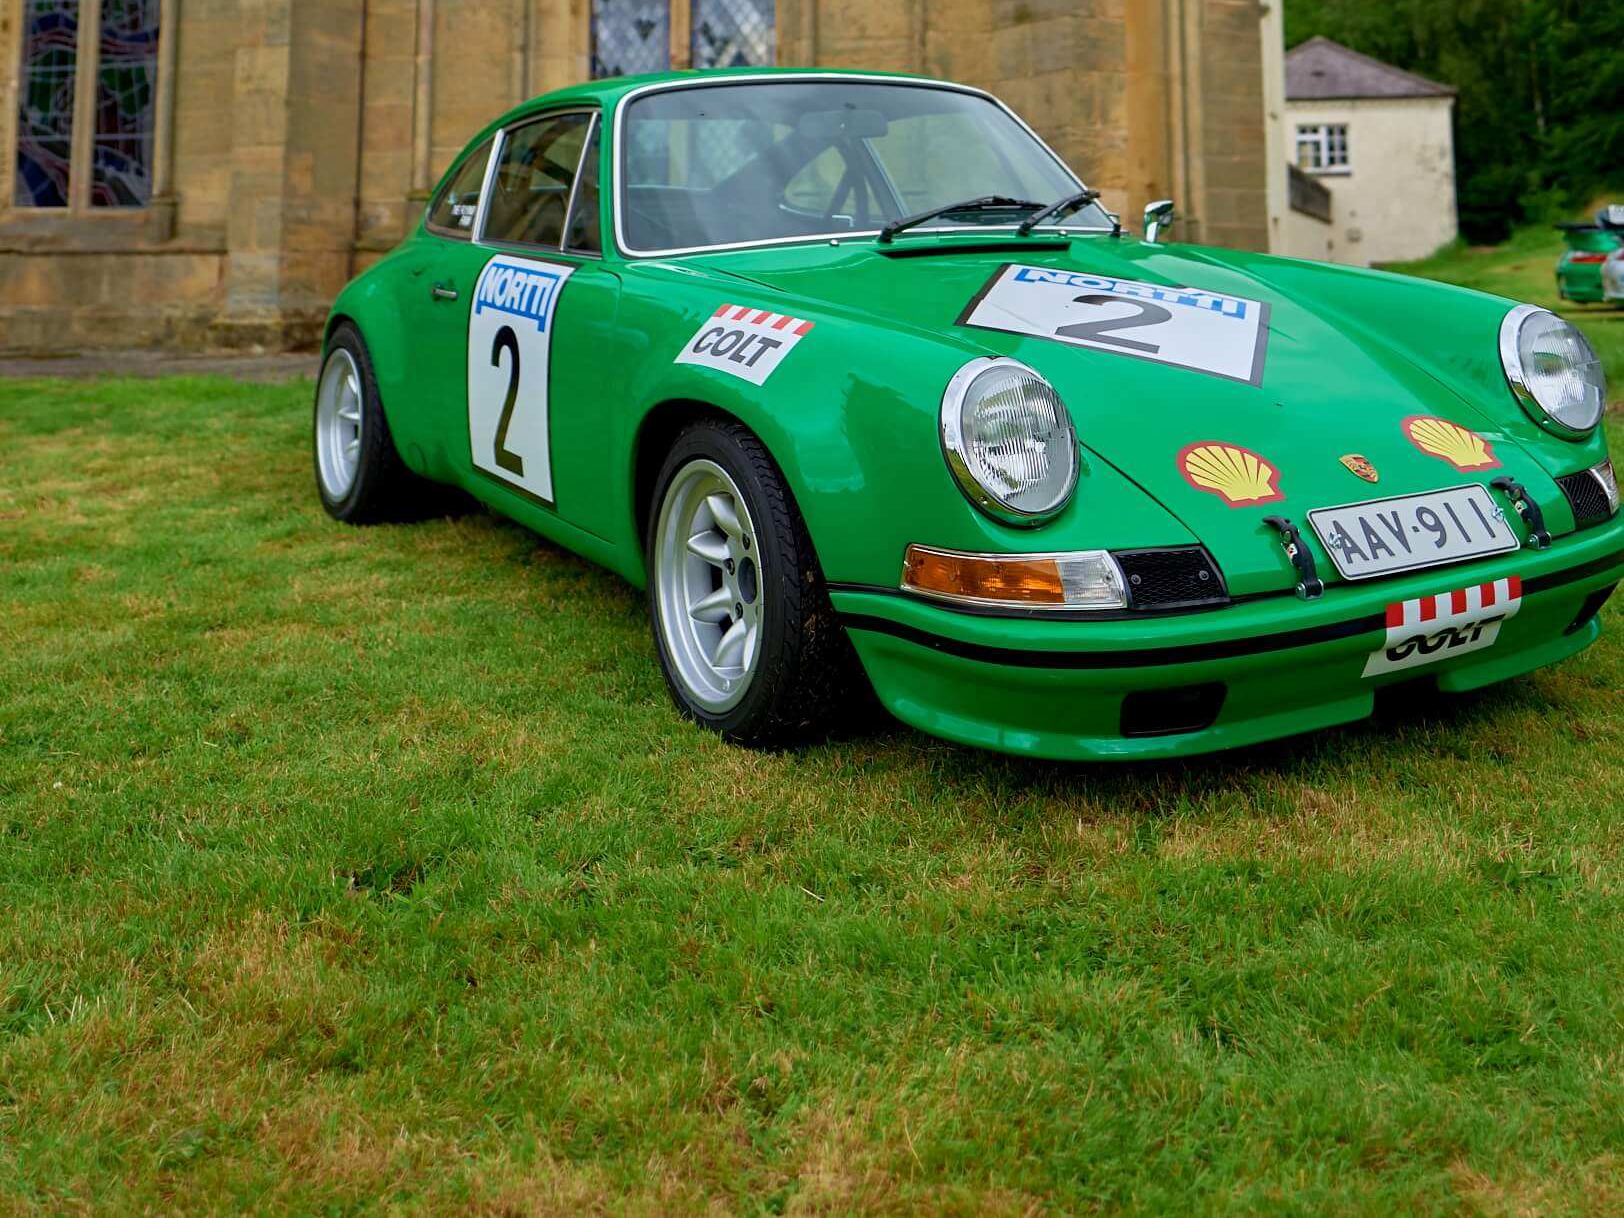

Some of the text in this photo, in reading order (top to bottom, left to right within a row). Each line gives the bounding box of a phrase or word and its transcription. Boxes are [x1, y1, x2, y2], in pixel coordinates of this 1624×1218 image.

[479, 266, 557, 318] NORTTI
[692, 326, 783, 368] COLT
[1054, 294, 1173, 354] 2
[490, 325, 525, 479] 2
[1331, 497, 1497, 565] AAV-911
[1386, 613, 1507, 662] COLT
